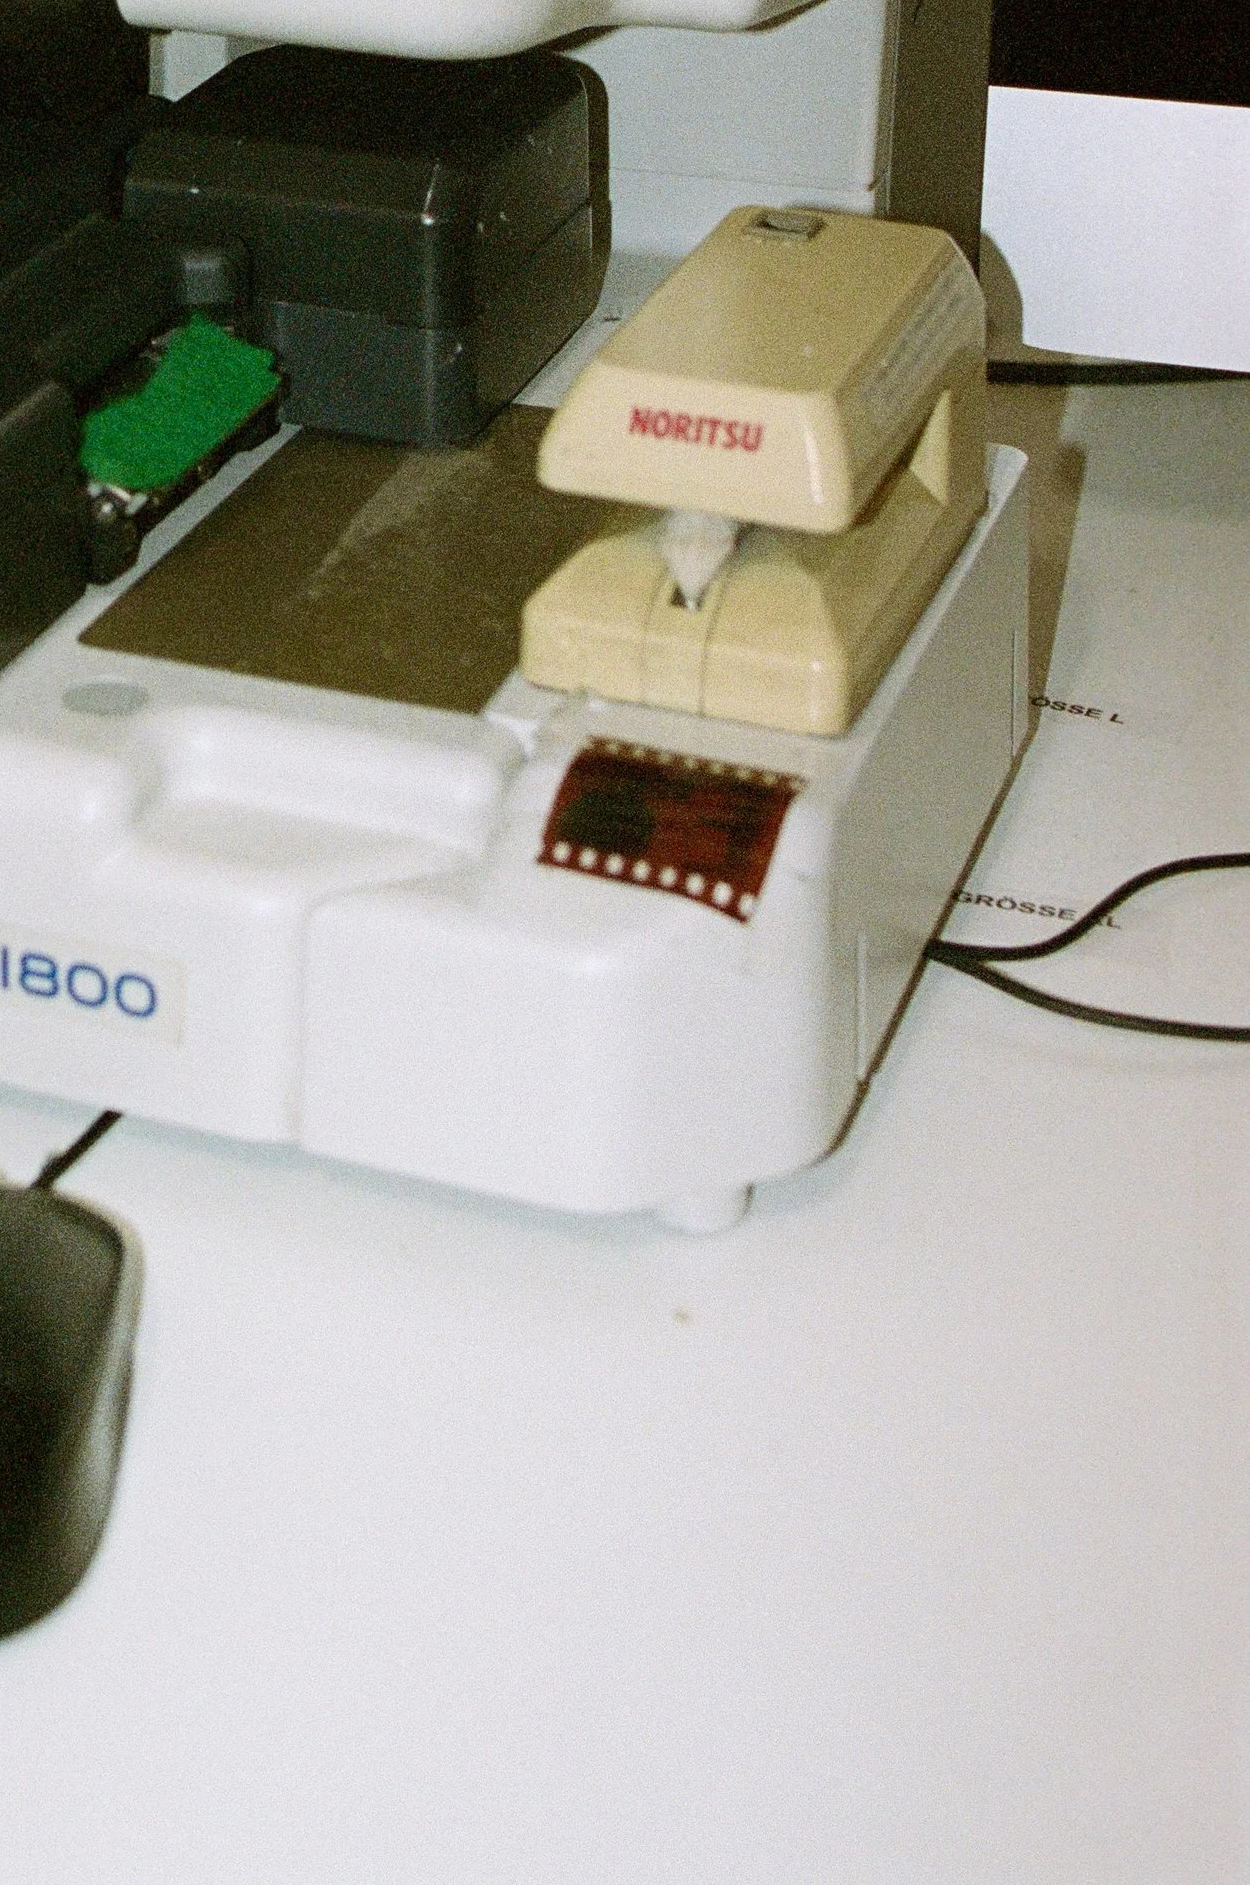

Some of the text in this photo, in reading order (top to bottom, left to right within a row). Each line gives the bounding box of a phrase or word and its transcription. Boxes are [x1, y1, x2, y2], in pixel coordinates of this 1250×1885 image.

[628, 405, 765, 455] NORITSU
[1031, 695, 1125, 725] ÖSSE L
